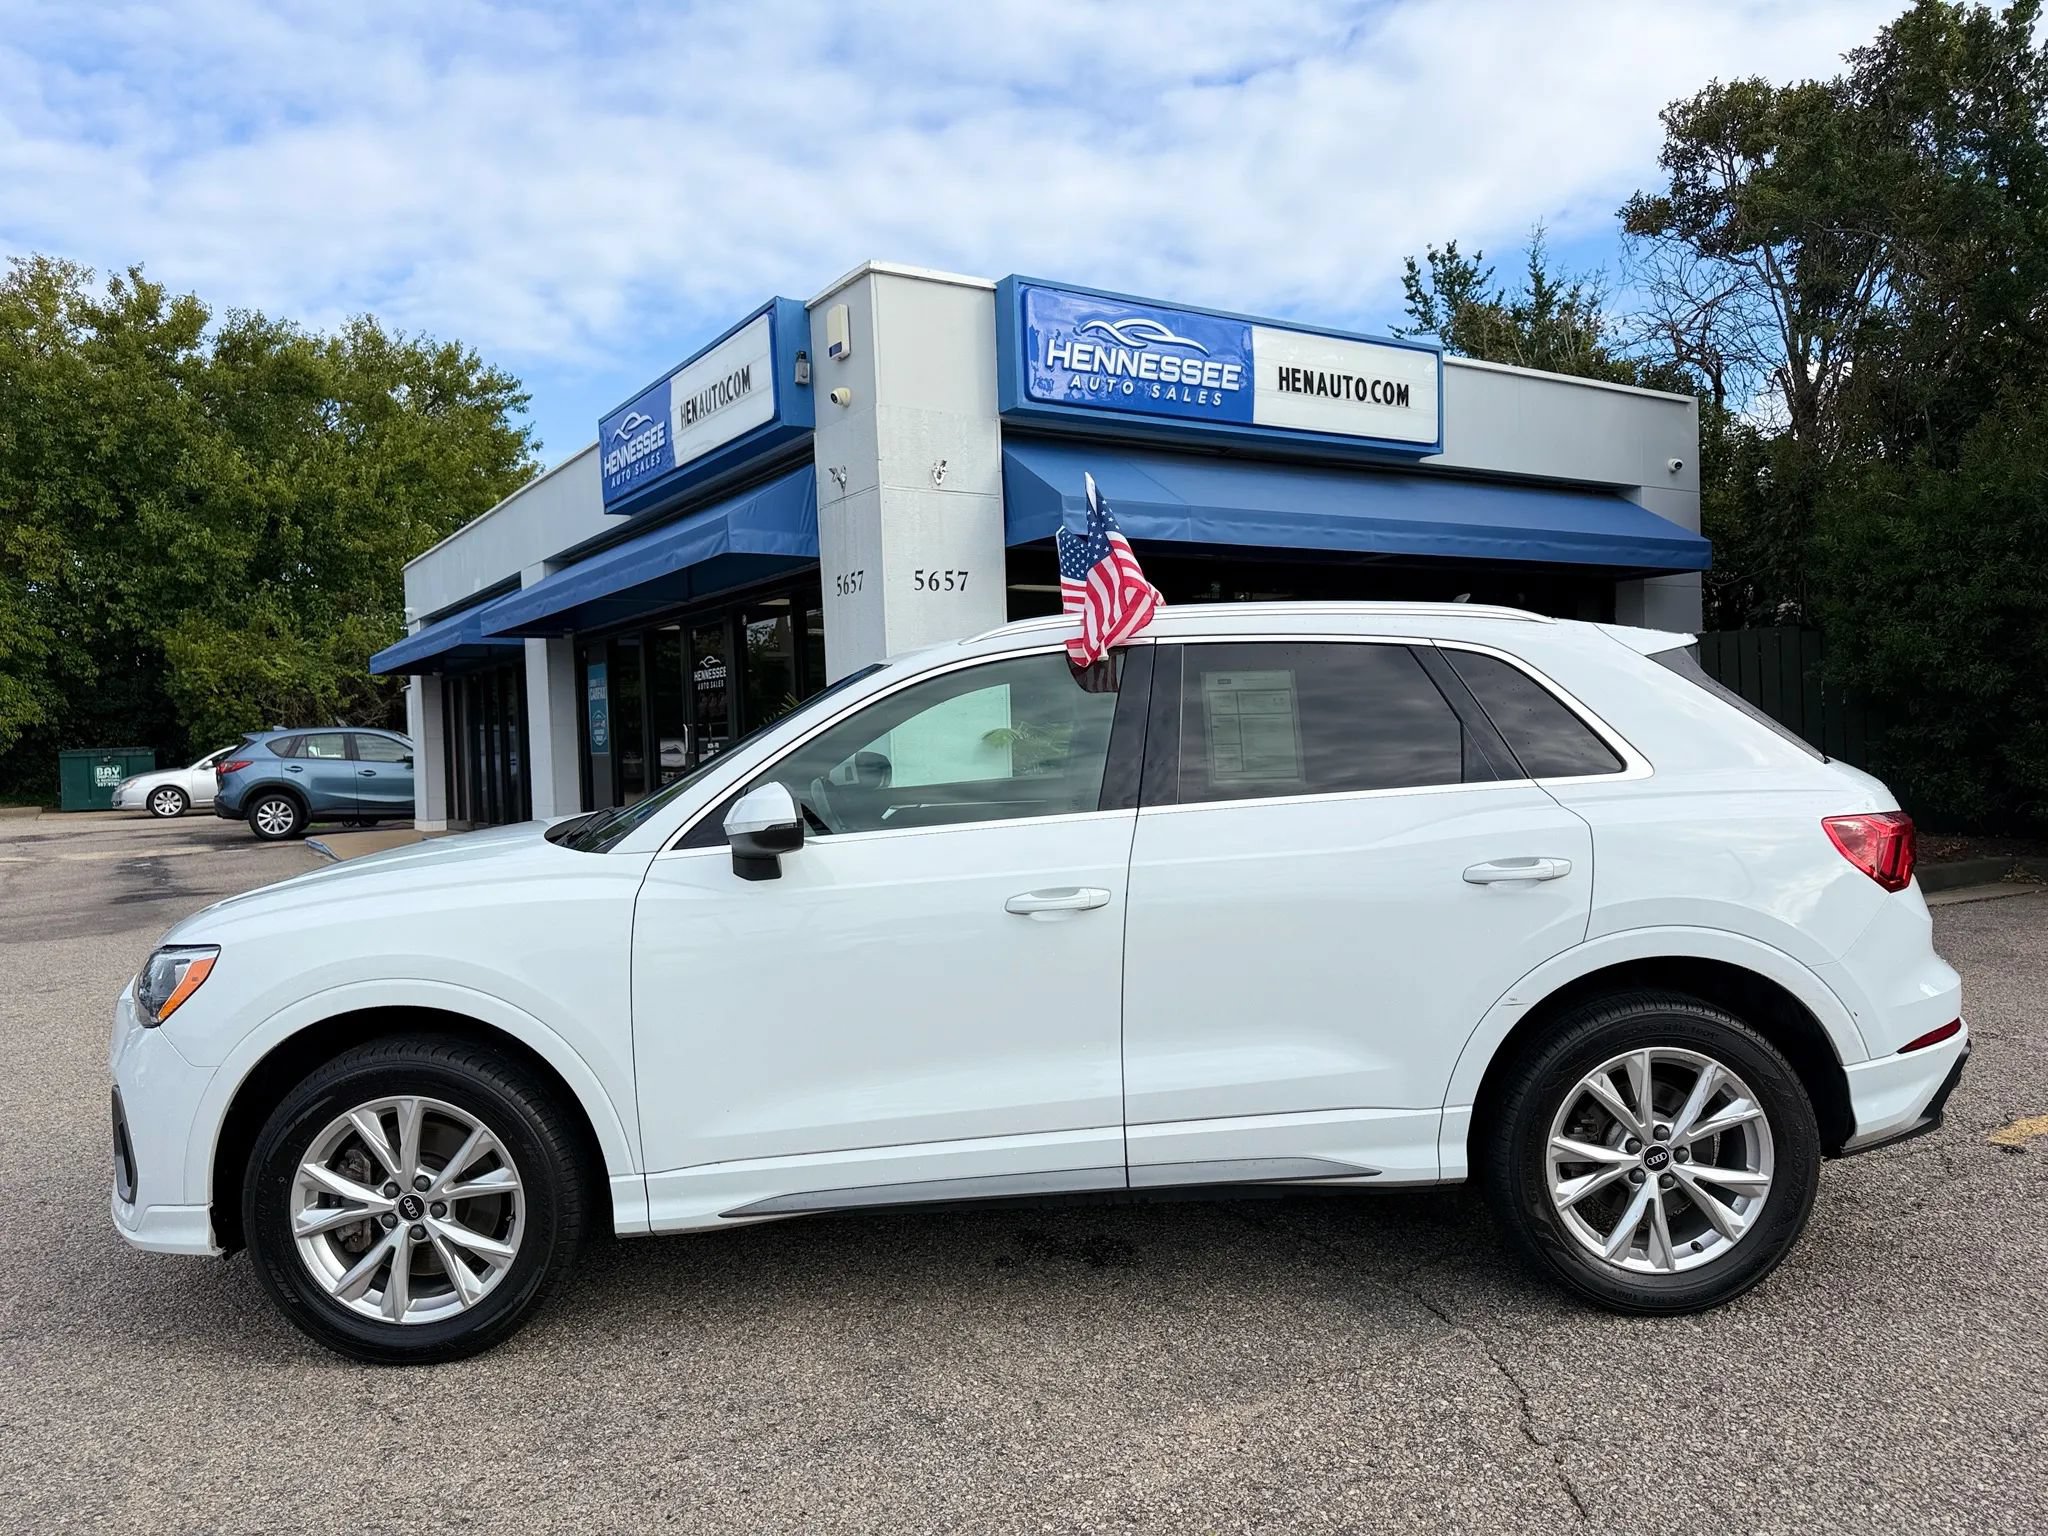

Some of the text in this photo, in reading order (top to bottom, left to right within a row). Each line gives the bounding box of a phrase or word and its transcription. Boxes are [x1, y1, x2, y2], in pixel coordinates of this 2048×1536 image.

[1046, 338, 1243, 391] HENNESSEE
[1070, 374, 1223, 406] AUTO SALES
[604, 421, 666, 478] HENNESSEE
[611, 451, 661, 489] AUTO SALES
[836, 569, 864, 597] 5657
[914, 568, 969, 592] 5657
[693, 665, 727, 682] HENNESSEE
[96, 766, 120, 776] BAY
